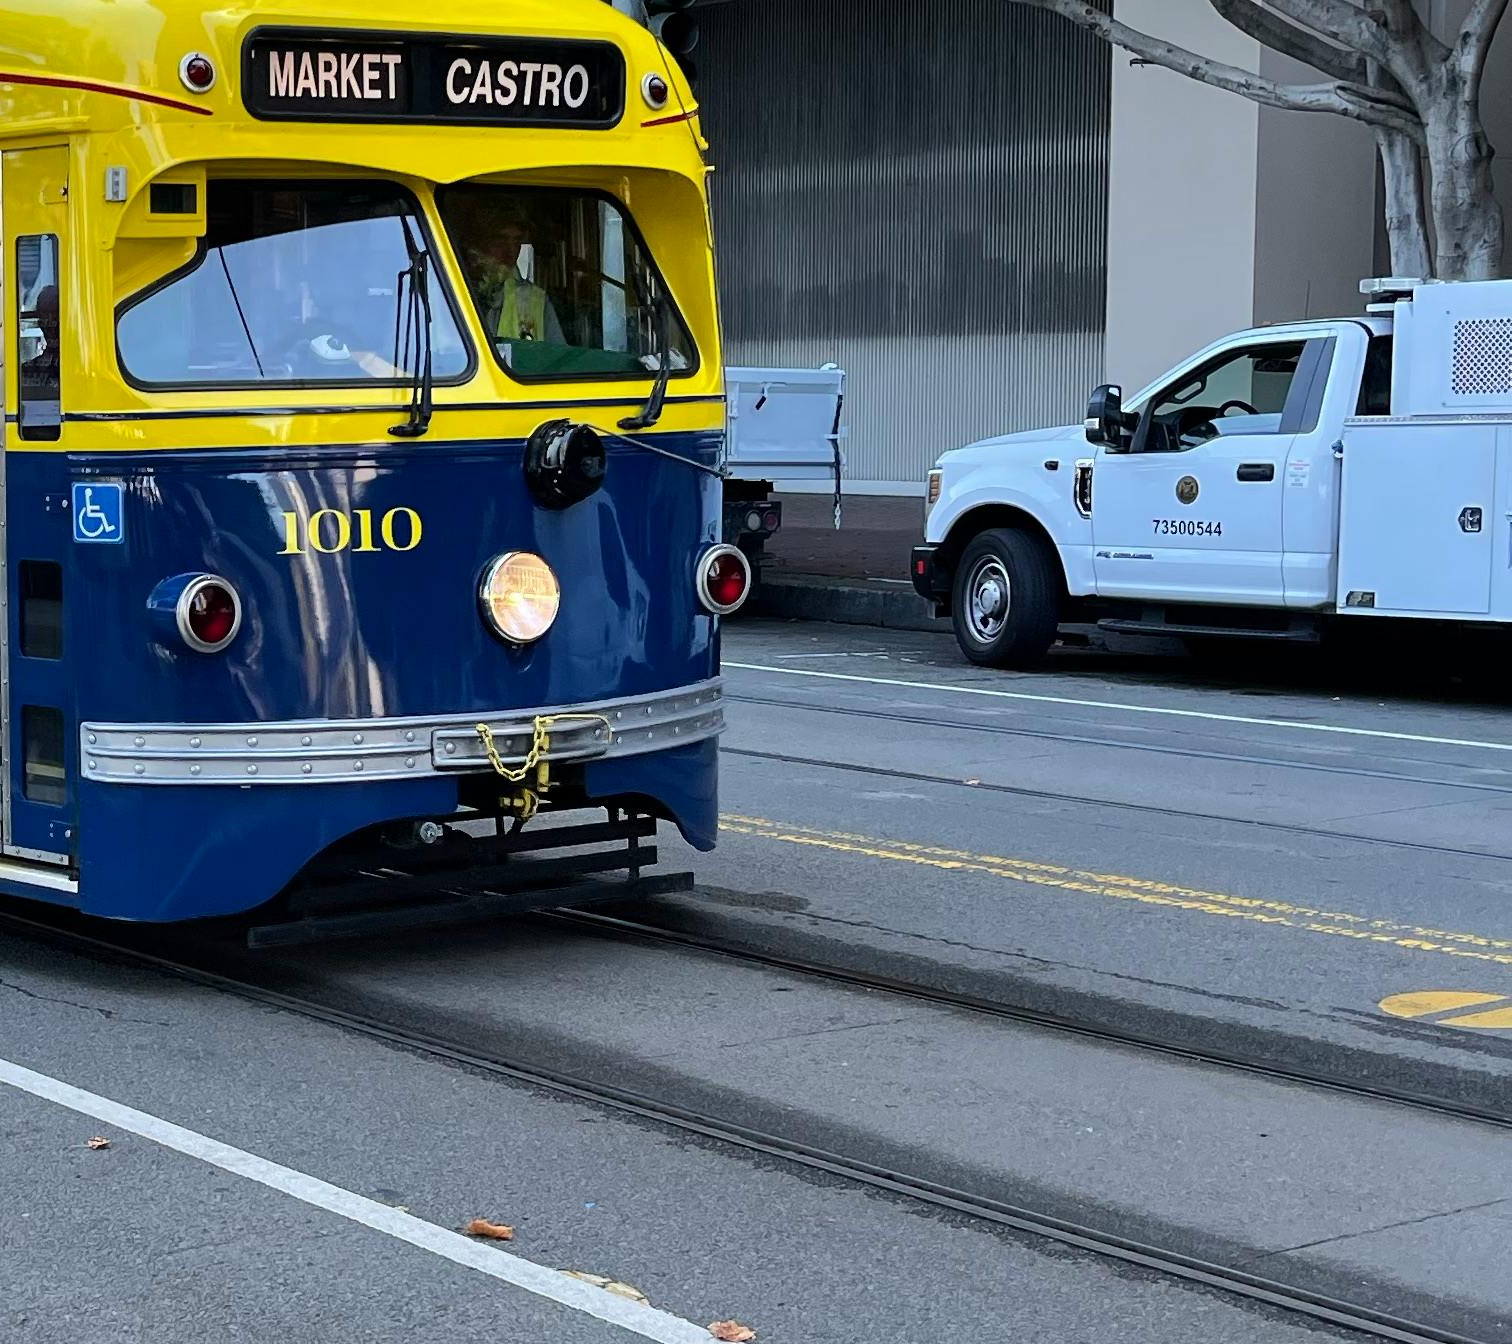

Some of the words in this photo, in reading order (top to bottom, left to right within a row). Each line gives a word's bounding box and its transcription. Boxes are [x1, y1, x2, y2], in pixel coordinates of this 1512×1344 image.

[269, 50, 402, 100] MARKET
[446, 58, 589, 109] CASTRO
[276, 506, 423, 555] 1010
[1152, 519, 1223, 537] 73500544
